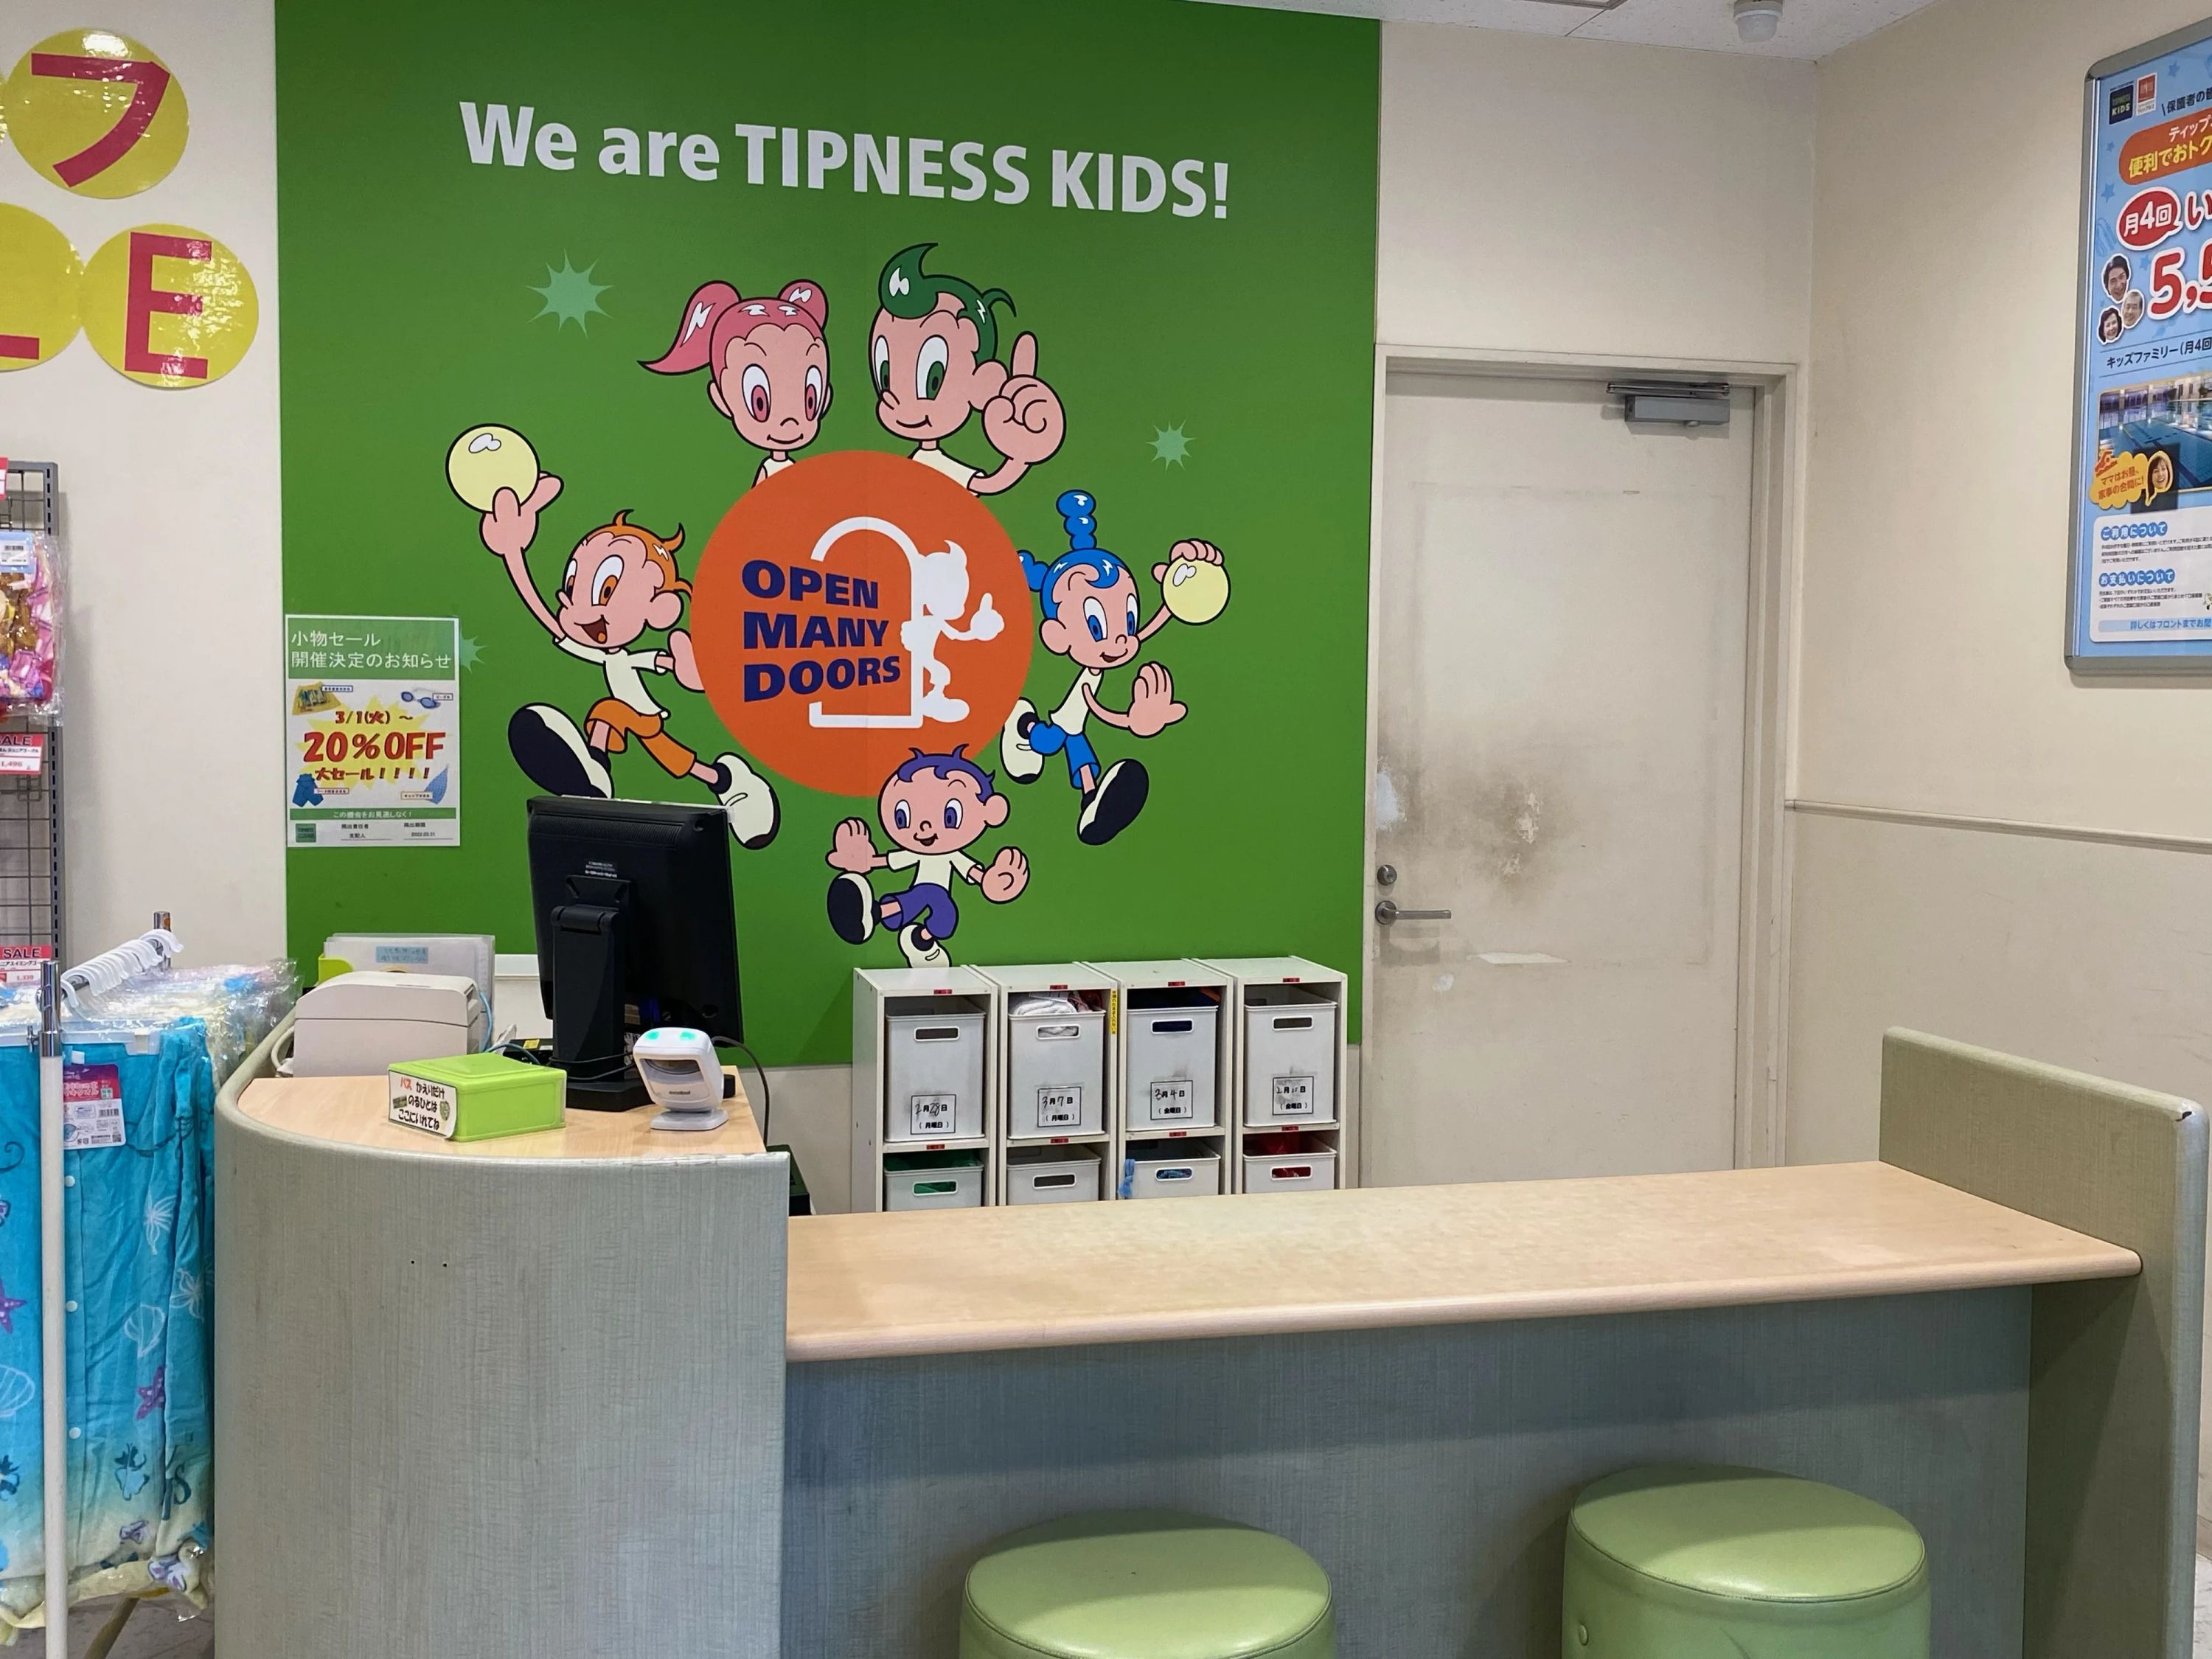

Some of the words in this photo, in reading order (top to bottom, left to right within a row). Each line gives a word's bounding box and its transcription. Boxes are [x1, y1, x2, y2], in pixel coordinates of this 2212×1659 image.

[2112, 103, 2131, 116] KIDS
[2168, 114, 2212, 143] ティップ
[459, 101, 577, 170] We
[598, 127, 720, 181] are
[735, 123, 1030, 205] TIPNESS
[1051, 149, 1228, 220] KIDS!
[2123, 201, 2172, 237] 月4回
[2101, 522, 2167, 539] ご利用について
[742, 560, 878, 609] OPEN
[2100, 571, 2174, 586] お支払いについて
[291, 630, 381, 647] 小物セール
[744, 611, 889, 650] MANY
[291, 651, 452, 669] 開催決定のお知らせ
[744, 655, 901, 703] DOORS
[0, 735, 32, 745] ALE
[303, 731, 446, 762] 20%OFF
[4, 947, 40, 959] SALE
